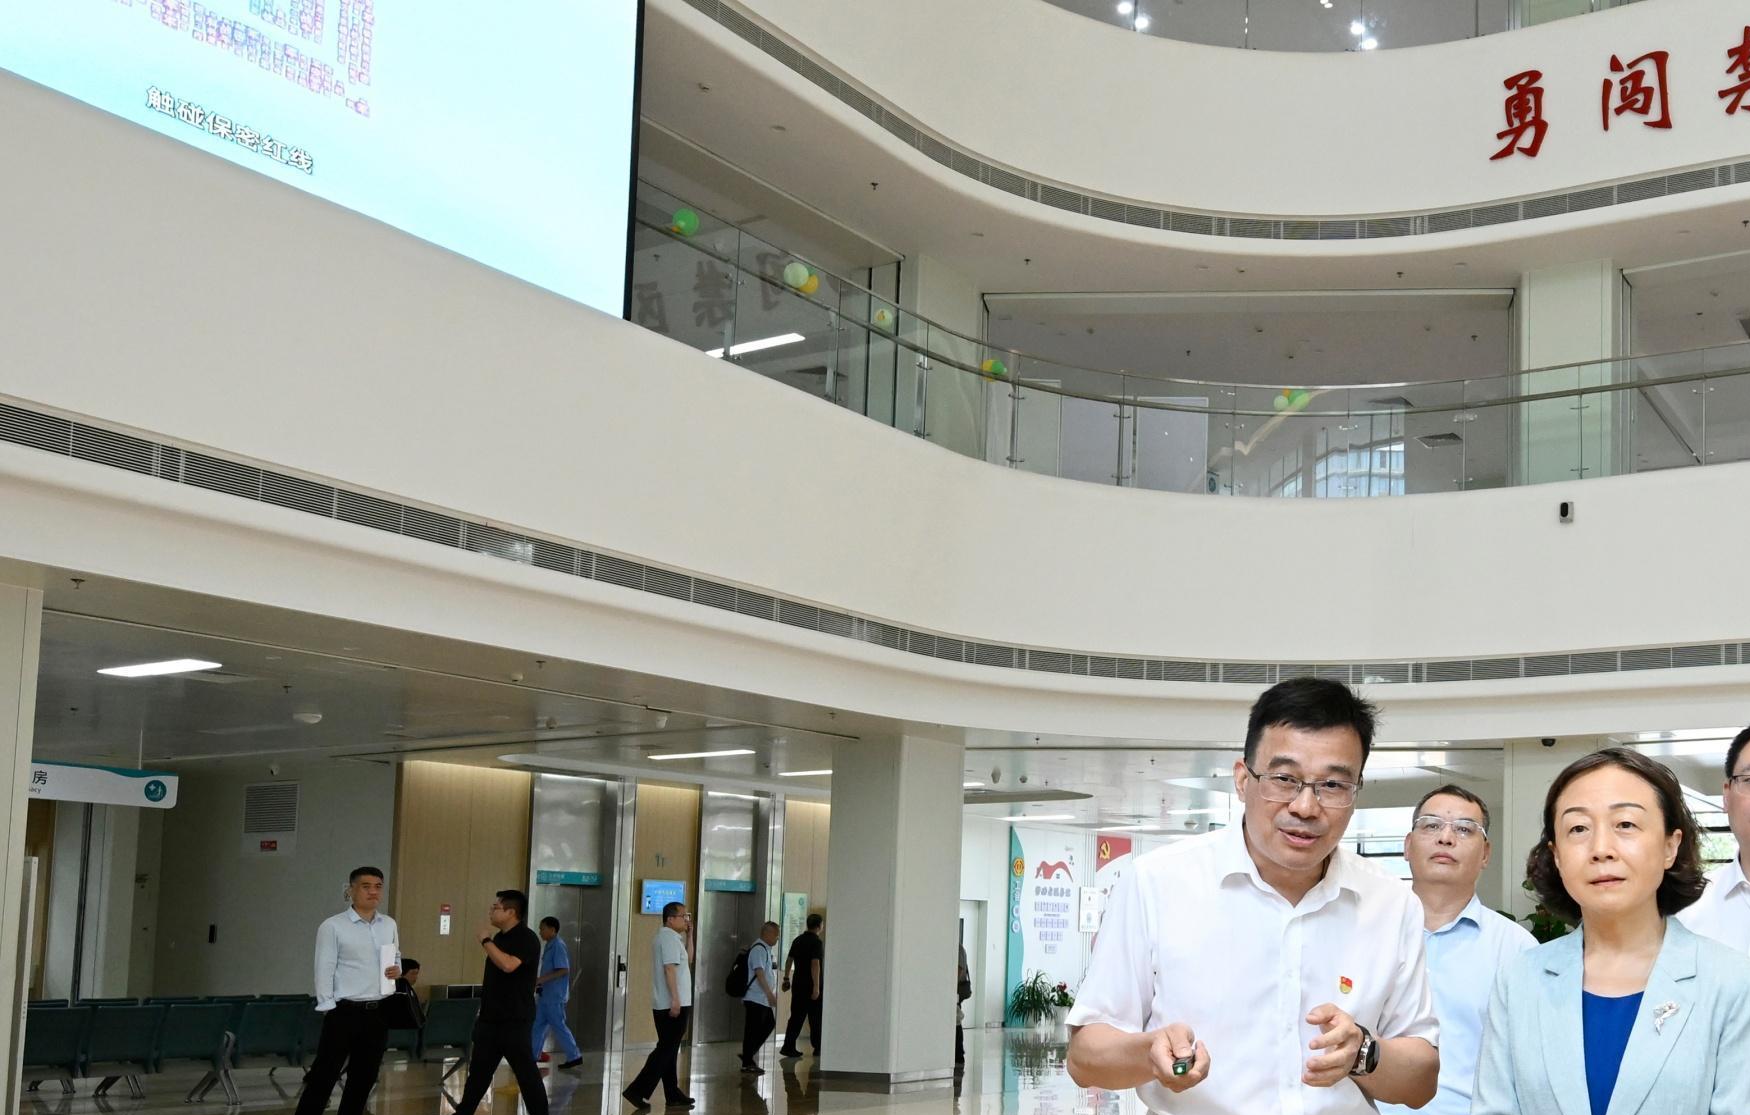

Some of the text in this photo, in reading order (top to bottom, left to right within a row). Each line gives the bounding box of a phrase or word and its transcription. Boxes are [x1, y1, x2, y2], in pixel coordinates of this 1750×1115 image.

[145, 85, 314, 175] 触碰保密红线
[32, 770, 48, 785] 房
